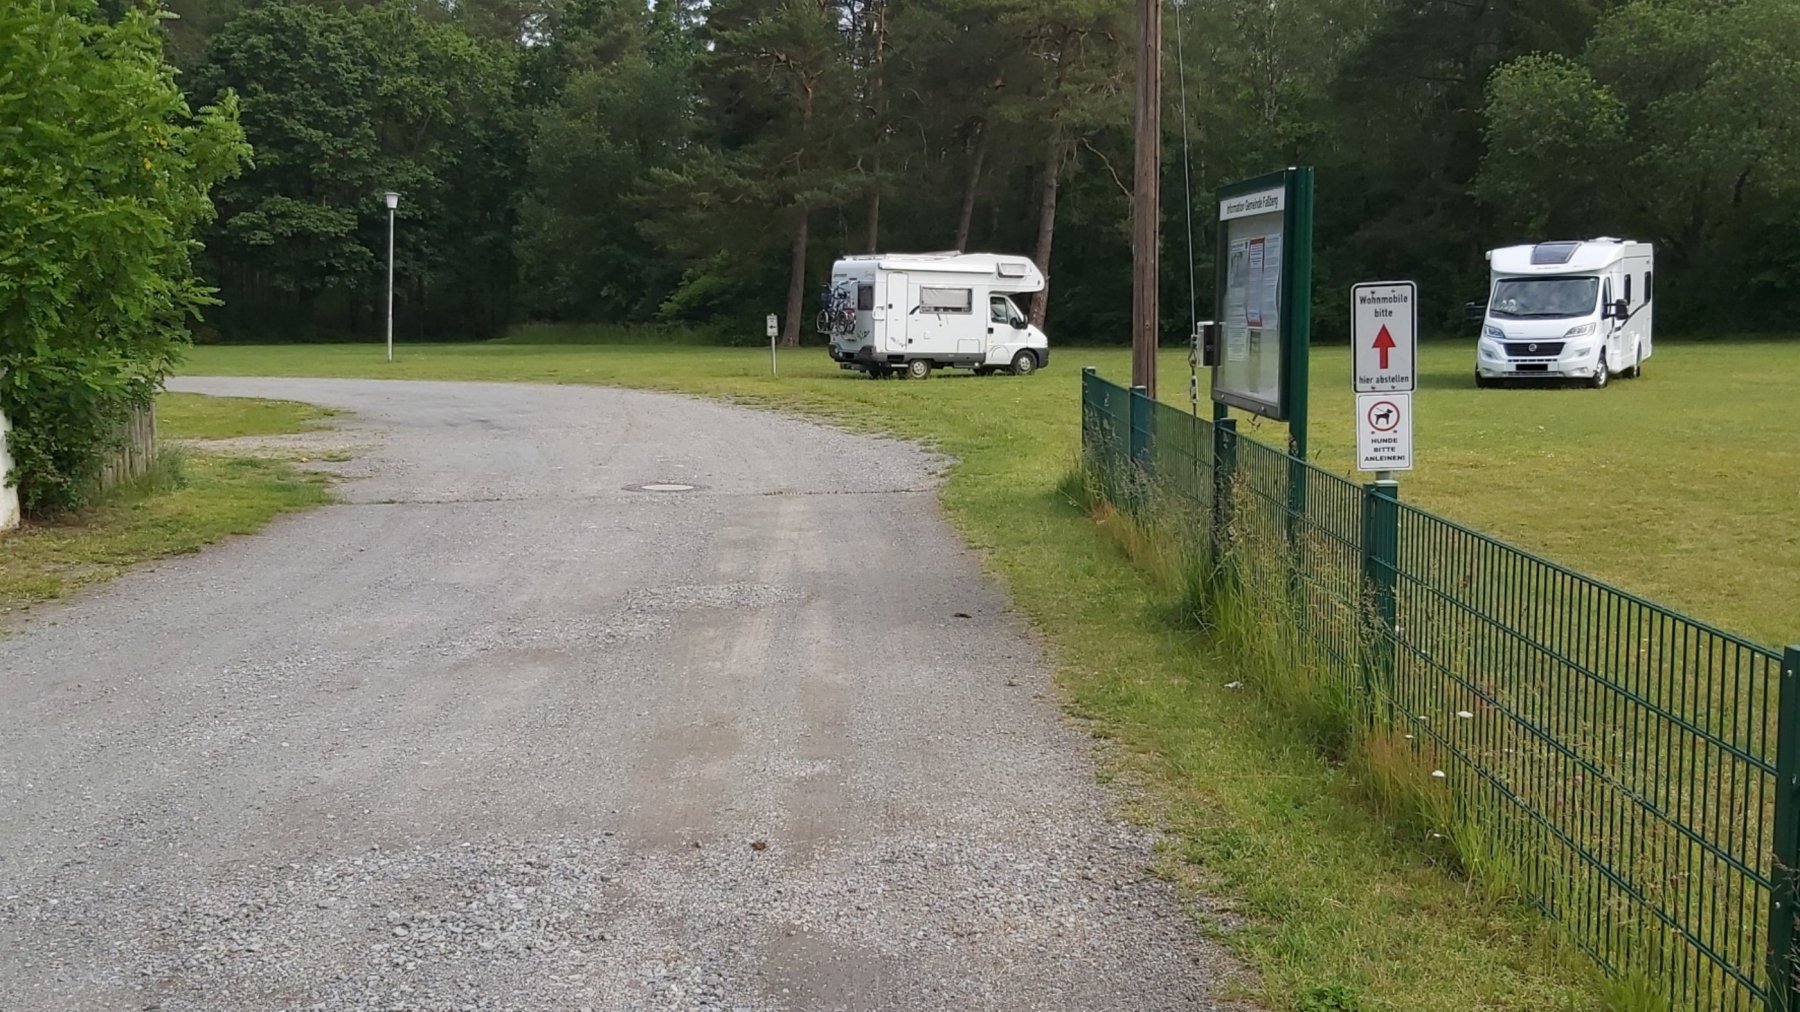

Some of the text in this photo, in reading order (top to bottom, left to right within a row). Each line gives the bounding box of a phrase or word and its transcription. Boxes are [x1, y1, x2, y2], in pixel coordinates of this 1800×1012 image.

[1226, 201, 1245, 214] Information
[1245, 196, 1263, 211] Gemeinde
[1359, 294, 1408, 305] Wohnmobile
[1374, 308, 1393, 318] bitte
[1359, 374, 1409, 384] hier abstellen
